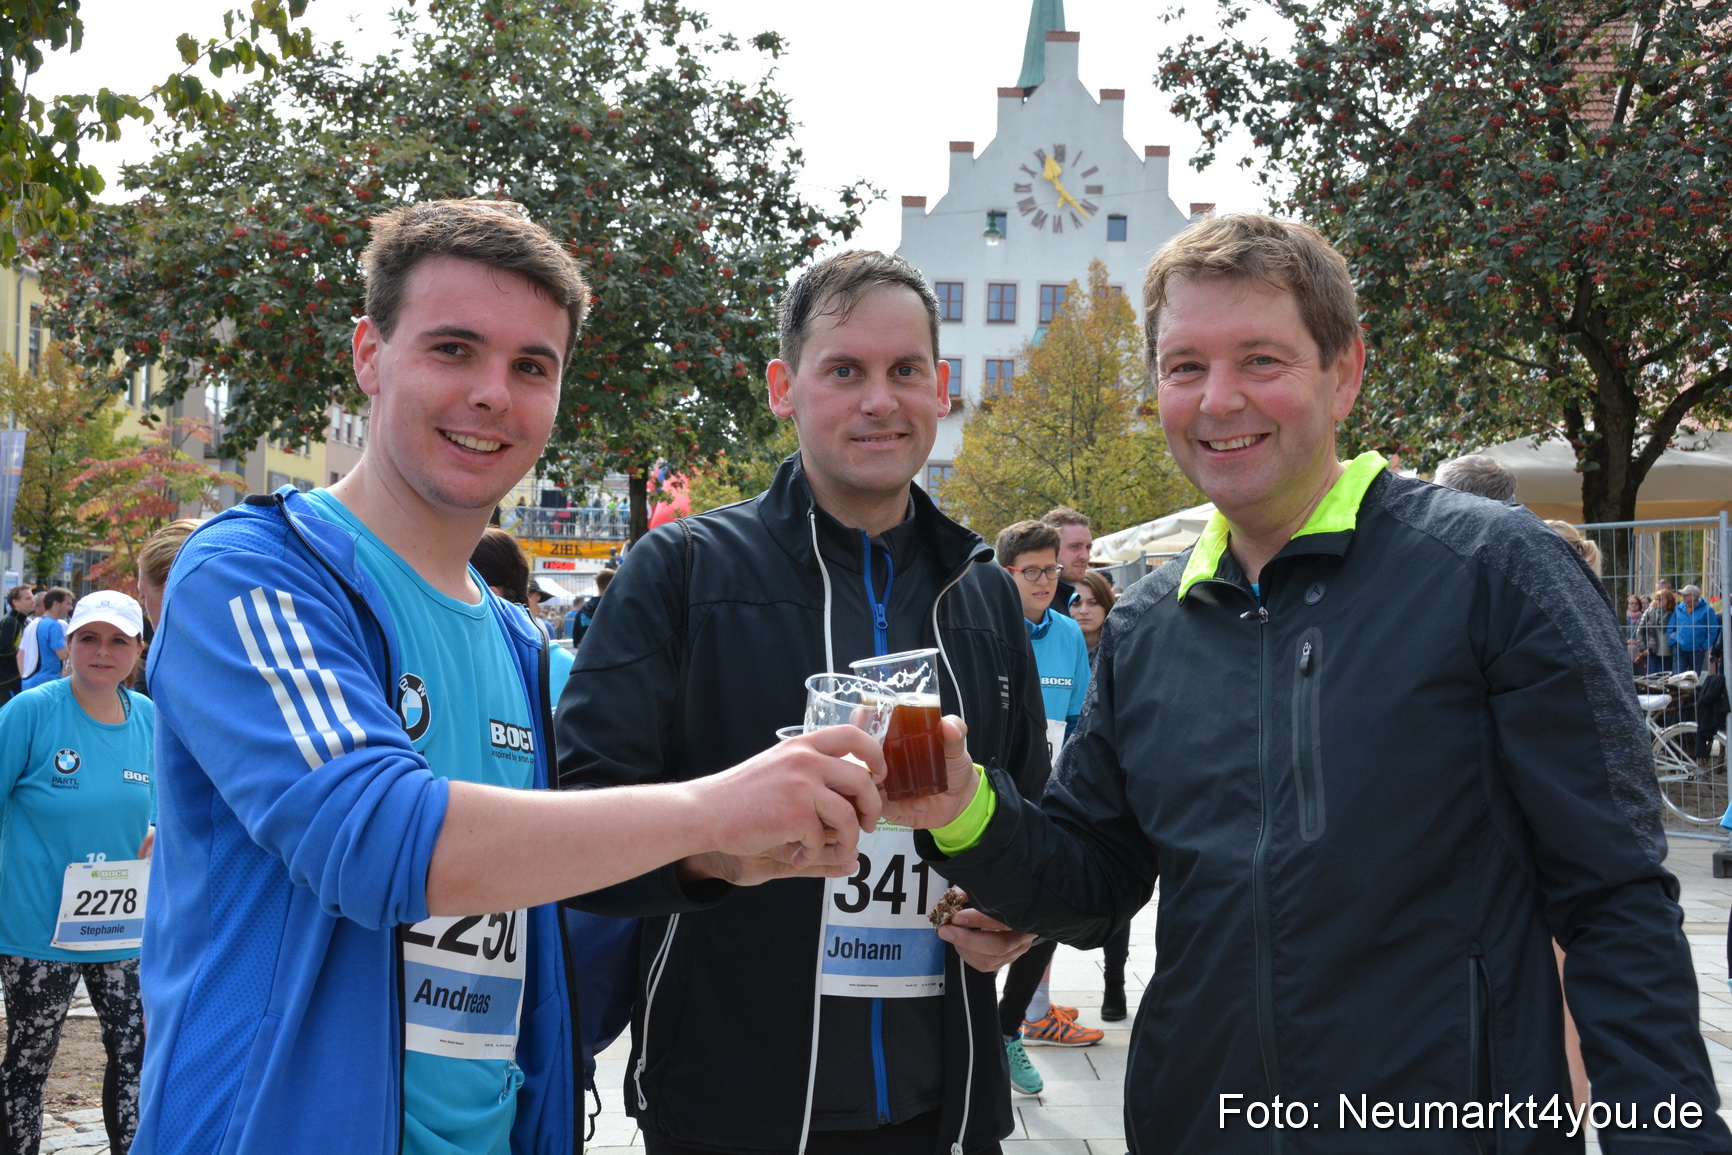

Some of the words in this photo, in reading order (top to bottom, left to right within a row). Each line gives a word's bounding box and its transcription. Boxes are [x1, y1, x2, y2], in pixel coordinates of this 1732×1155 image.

[550, 543, 583, 556] ZIEL
[398, 677, 427, 698] BW
[1041, 676, 1074, 687] BOCK
[51, 776, 79, 786] PARTL
[123, 769, 149, 784] BOC
[100, 869, 129, 878] BOCK
[833, 852, 930, 915] 341
[73, 888, 137, 916] 2278
[80, 924, 125, 937] Stephanie
[827, 936, 902, 961] Johann
[413, 978, 491, 1015] Andreas
